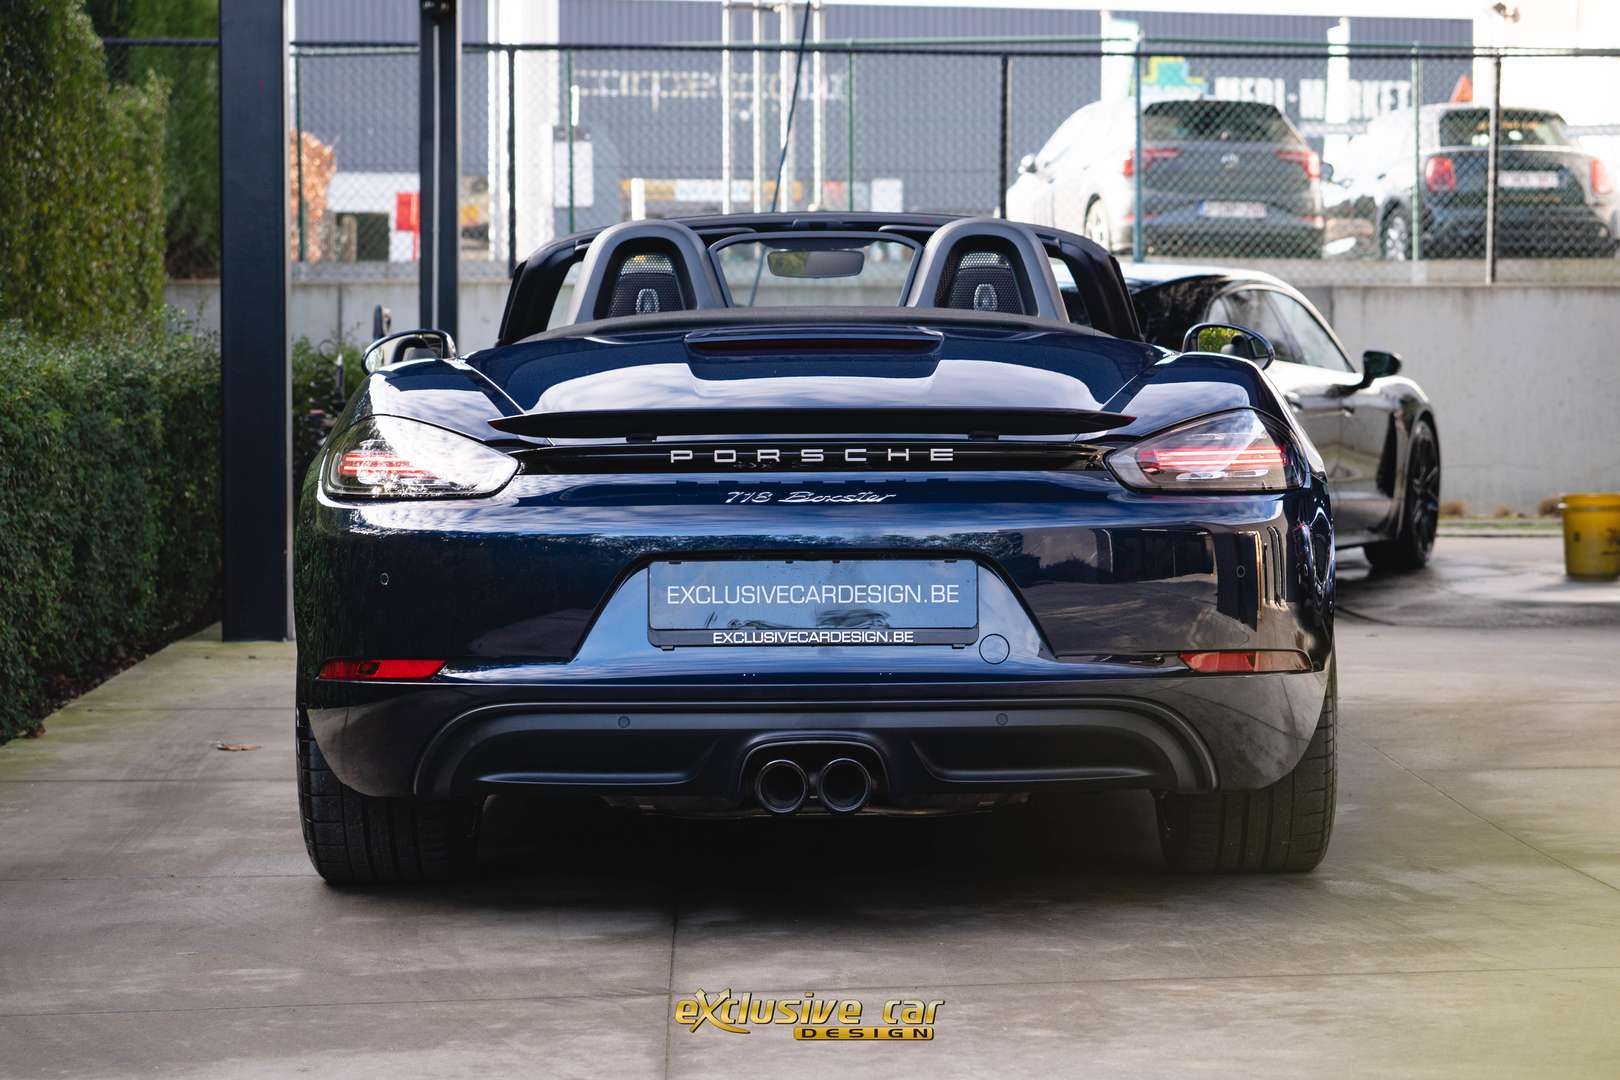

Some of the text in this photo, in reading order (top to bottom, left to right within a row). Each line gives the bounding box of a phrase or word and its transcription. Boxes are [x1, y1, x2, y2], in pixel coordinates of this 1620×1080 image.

[670, 448, 954, 463] PORSCHE
[724, 491, 897, 504] 718 Boxster
[666, 584, 960, 605] EXCLUSIVECARDESIGN.BE
[712, 630, 914, 644] EXCLUSIVECARDESIGN.BE
